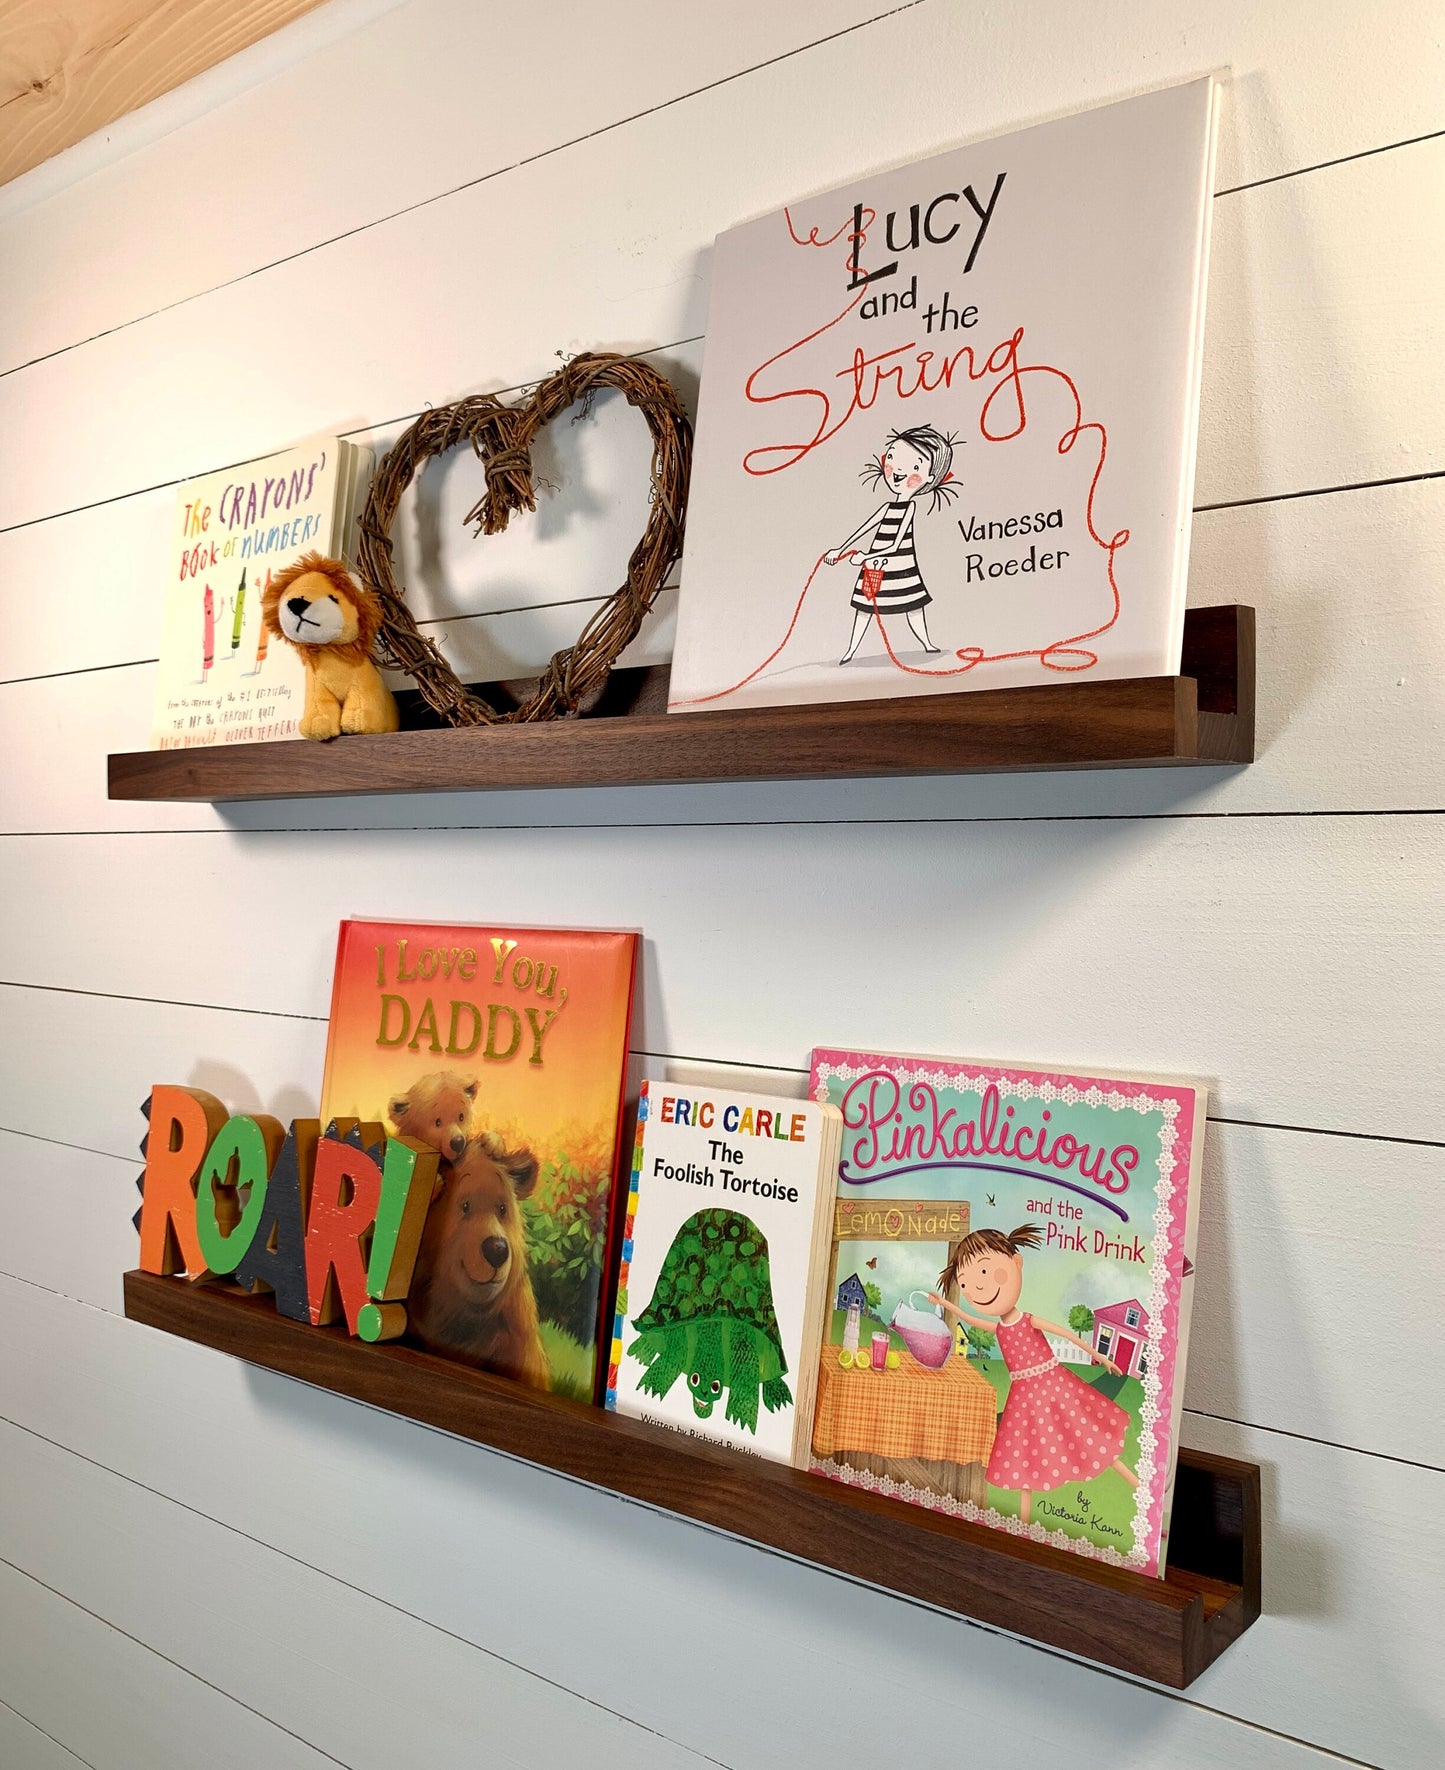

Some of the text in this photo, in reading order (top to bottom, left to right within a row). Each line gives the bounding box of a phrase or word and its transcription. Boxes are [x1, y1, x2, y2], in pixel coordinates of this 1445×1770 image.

[847, 172, 1007, 292] Lucy
[860, 275, 979, 334] and the
[743, 327, 1026, 476] String
[183, 451, 326, 539] The CRAYONS'
[957, 508, 1063, 543] Vanessa
[965, 546, 1070, 584] Roeder
[375, 937, 569, 1007] I Love You,
[375, 993, 558, 1064] DADDY
[660, 1097, 715, 1129] ERIC
[723, 1105, 807, 1142] CARLE
[841, 1070, 1139, 1194] Pinkalicious
[708, 1139, 744, 1165] The
[653, 1157, 799, 1203] Foolish Tortoise
[136, 1084, 428, 1342] ROAR!
[1026, 1197, 1084, 1221] and the
[1046, 1222, 1146, 1264] Pink Drink
[1037, 1500, 1124, 1537] Victoria Kann
[1077, 1490, 1091, 1513] by
